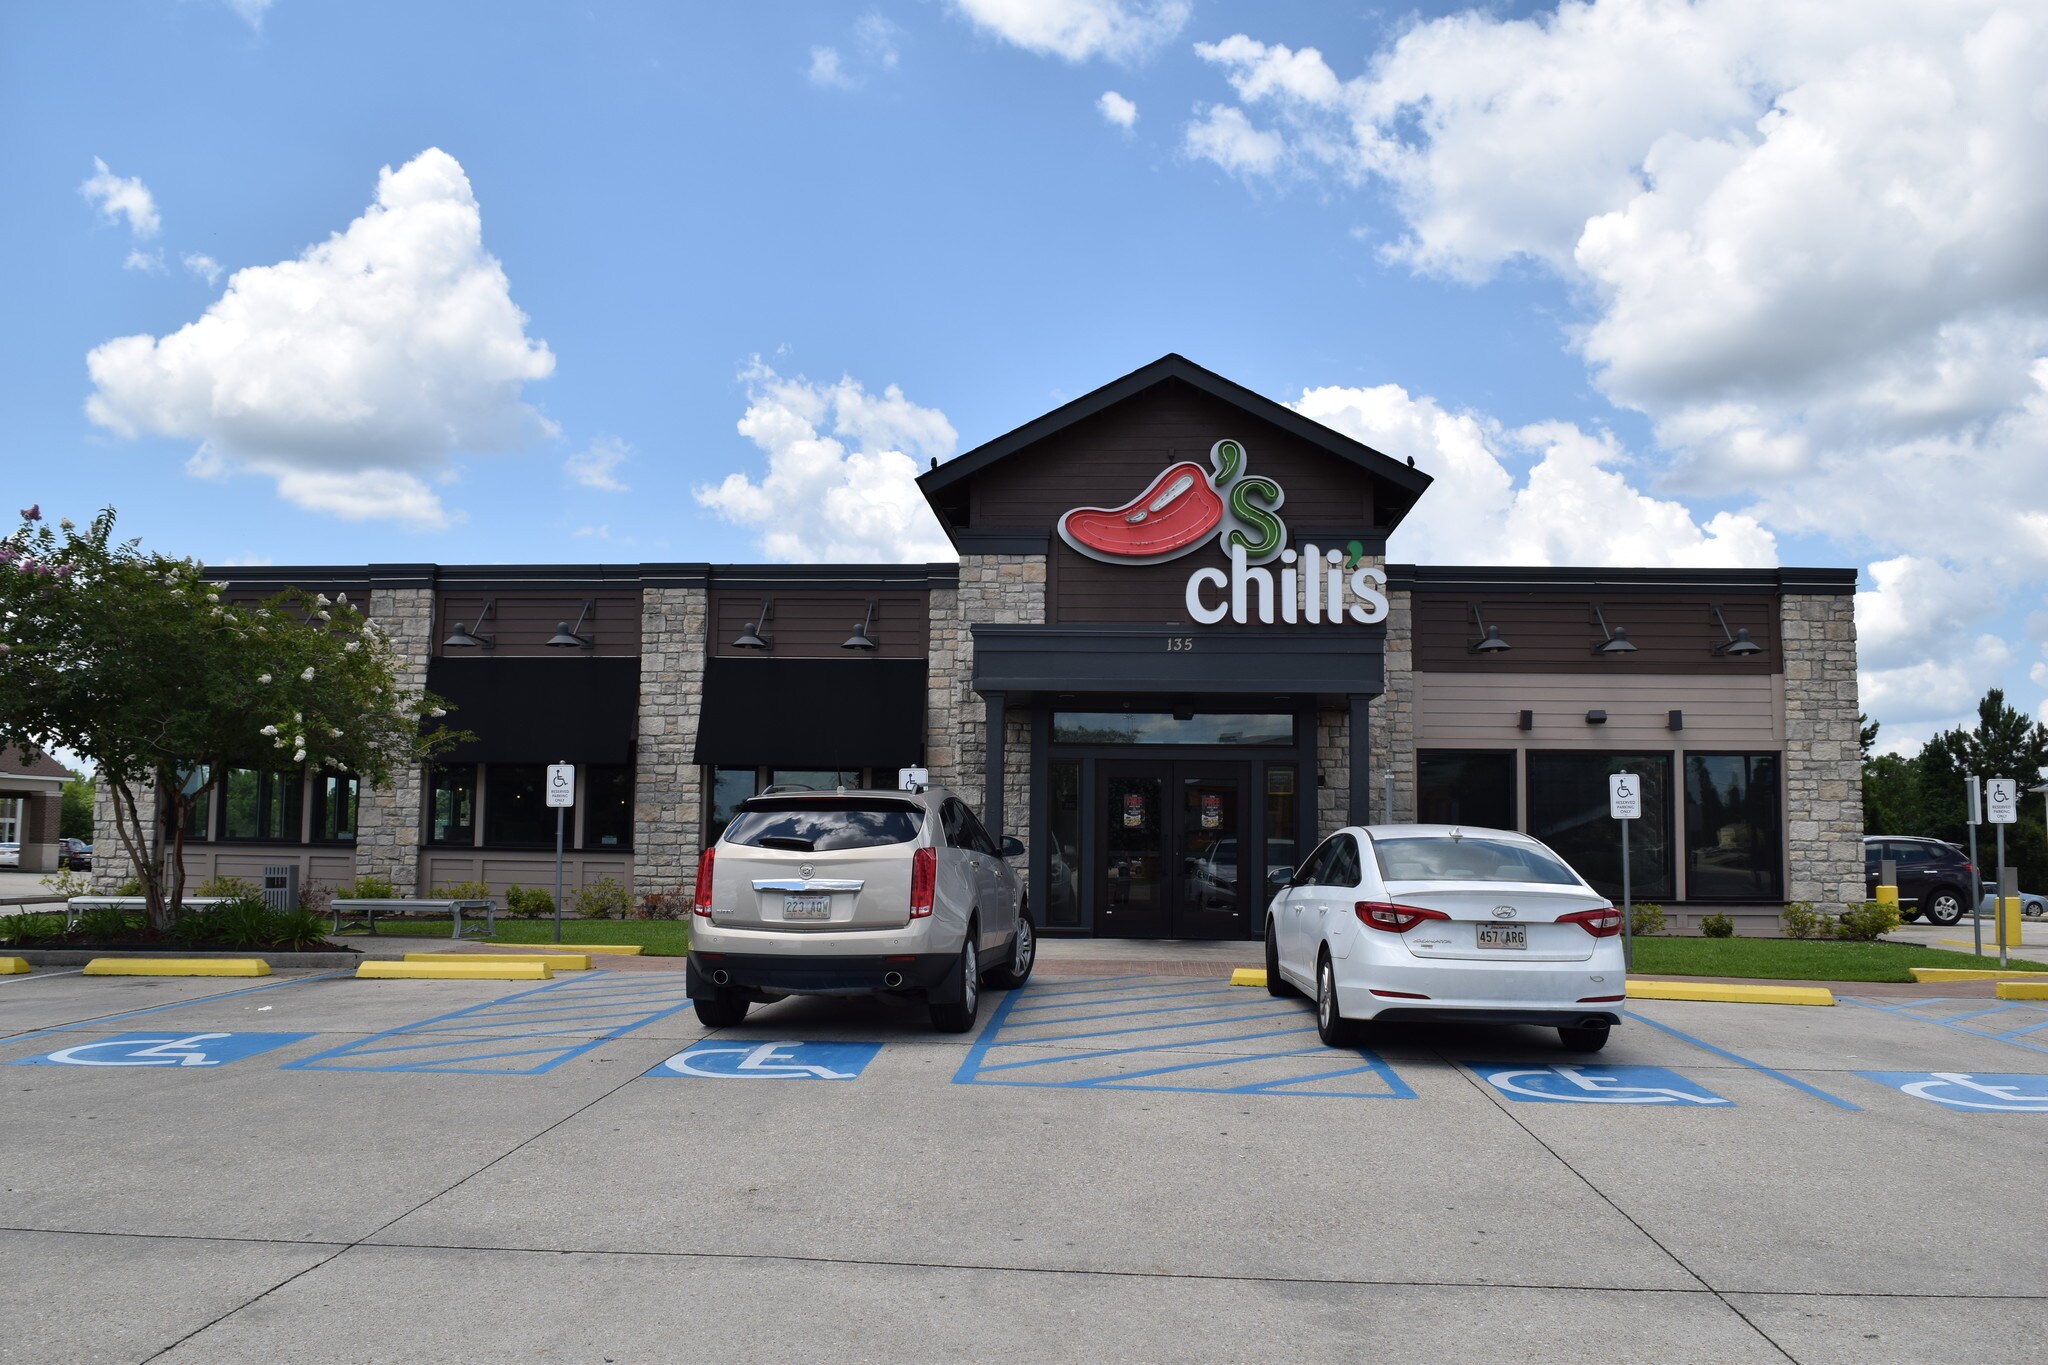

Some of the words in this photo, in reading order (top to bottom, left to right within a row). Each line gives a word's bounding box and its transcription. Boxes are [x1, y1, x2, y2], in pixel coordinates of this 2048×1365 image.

[1185, 540, 1390, 625] chili's
[1167, 637, 1193, 651] 135
[786, 901, 804, 913] 223
[1480, 930, 1498, 943] 457
[1505, 931, 1524, 944] ARG
